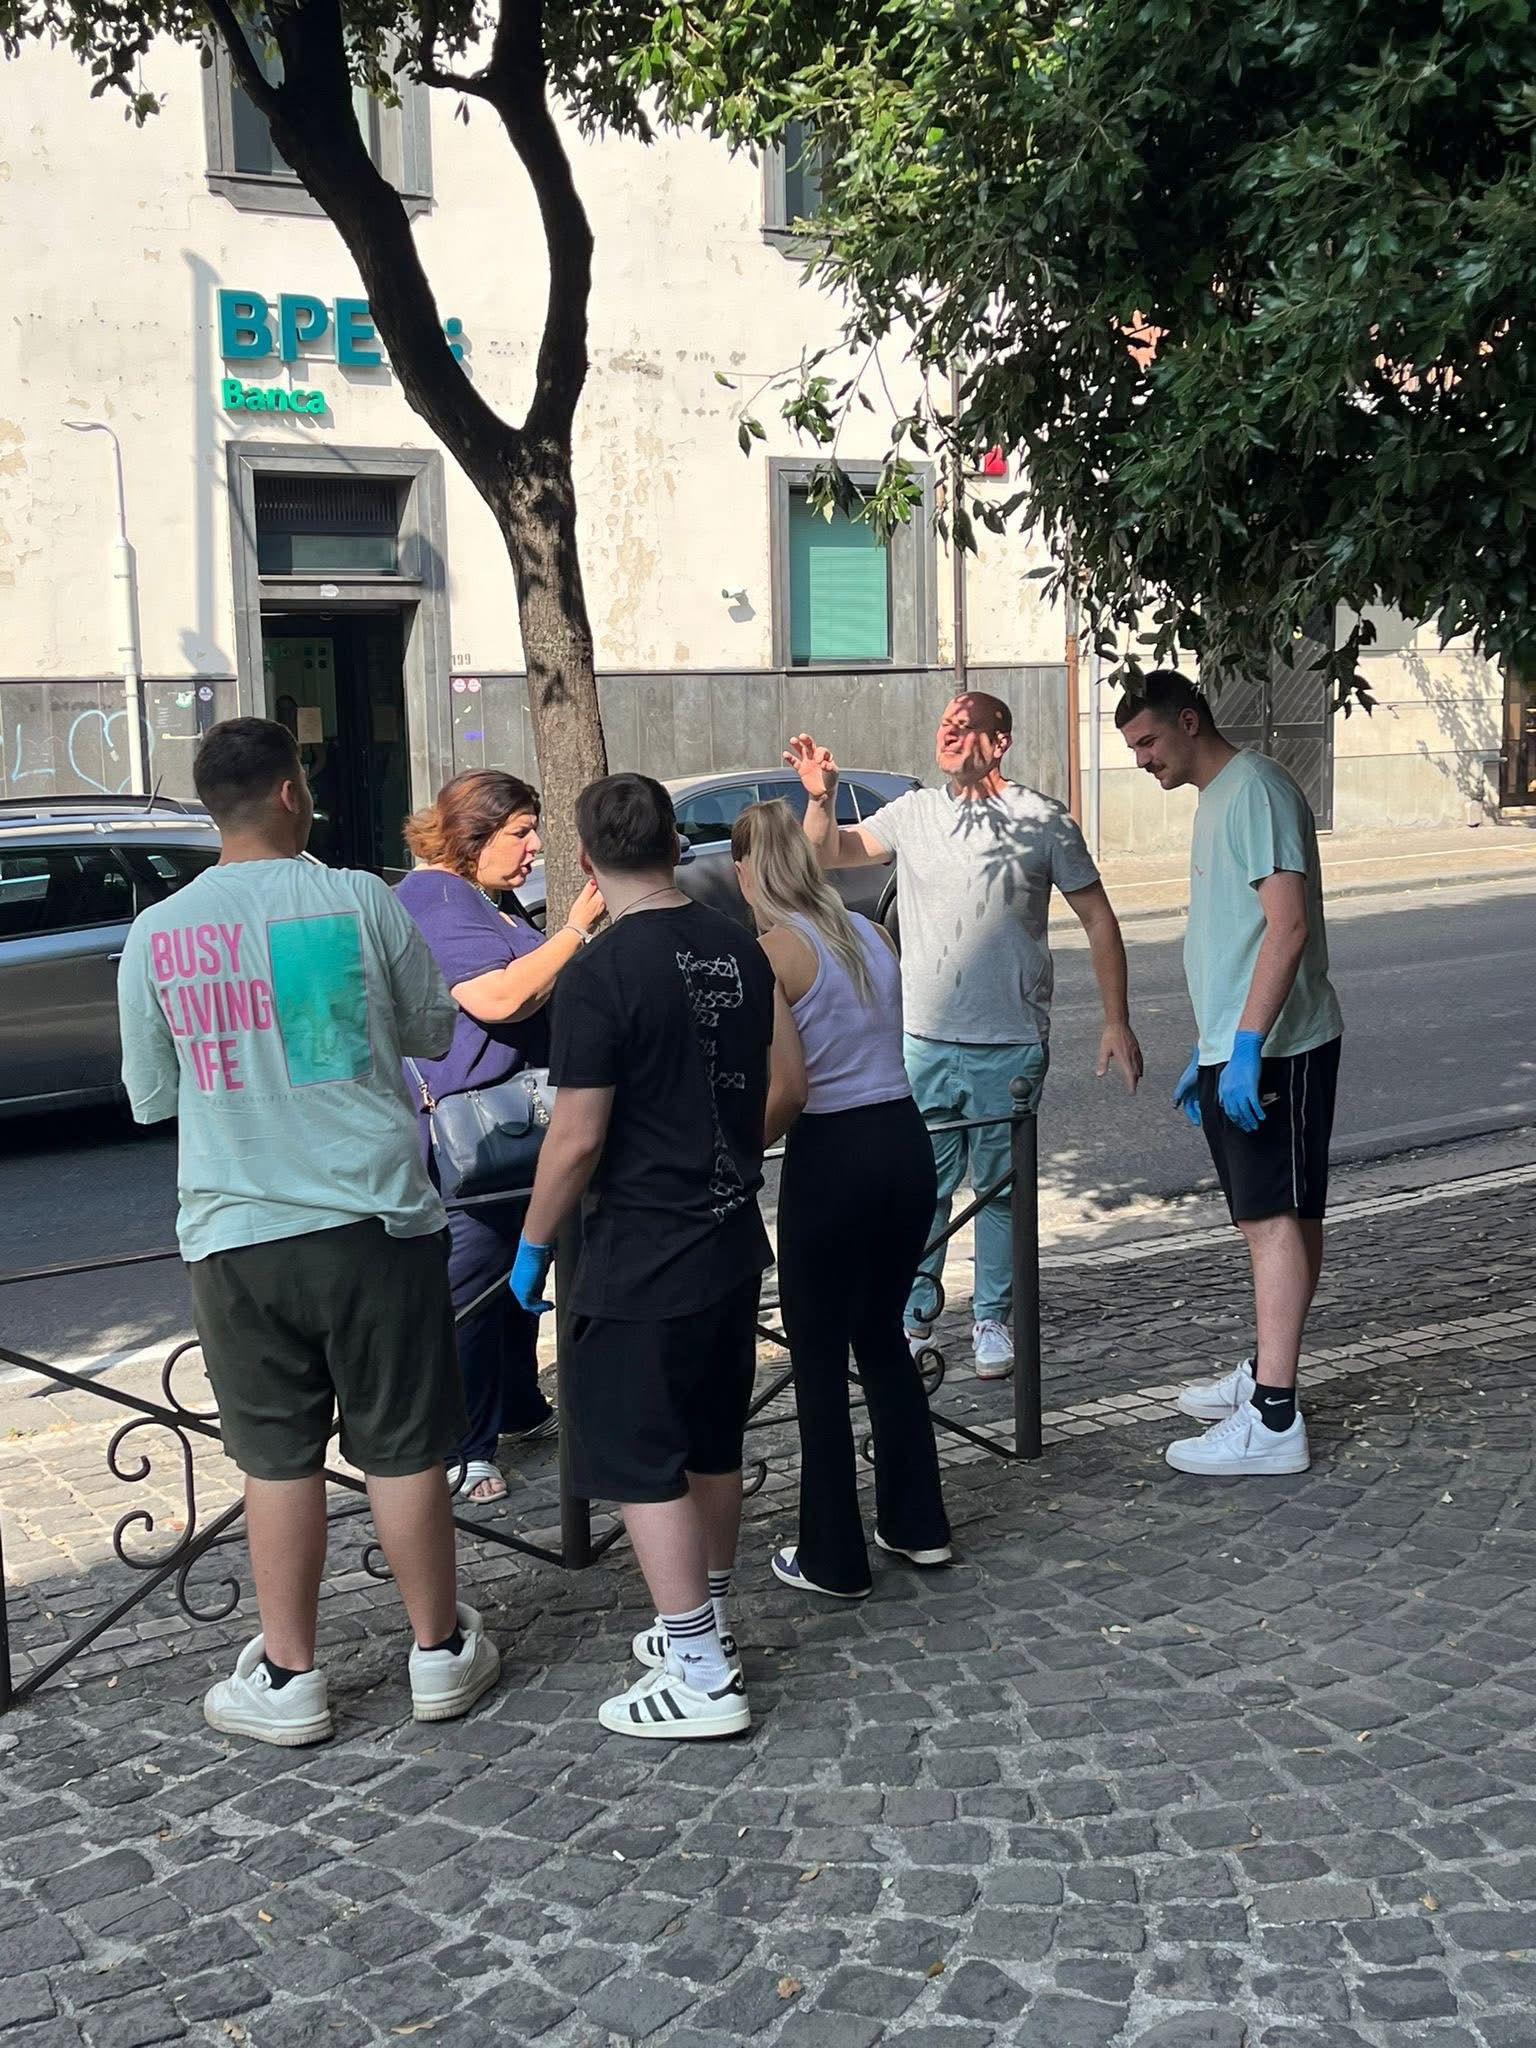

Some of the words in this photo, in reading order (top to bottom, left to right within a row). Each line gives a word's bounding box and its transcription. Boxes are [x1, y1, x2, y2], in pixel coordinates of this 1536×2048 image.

[222, 378, 326, 415] Banca
[151, 923, 243, 982] BUSY
[160, 979, 272, 1036] LIVING
[178, 1039, 244, 1092] IFE
